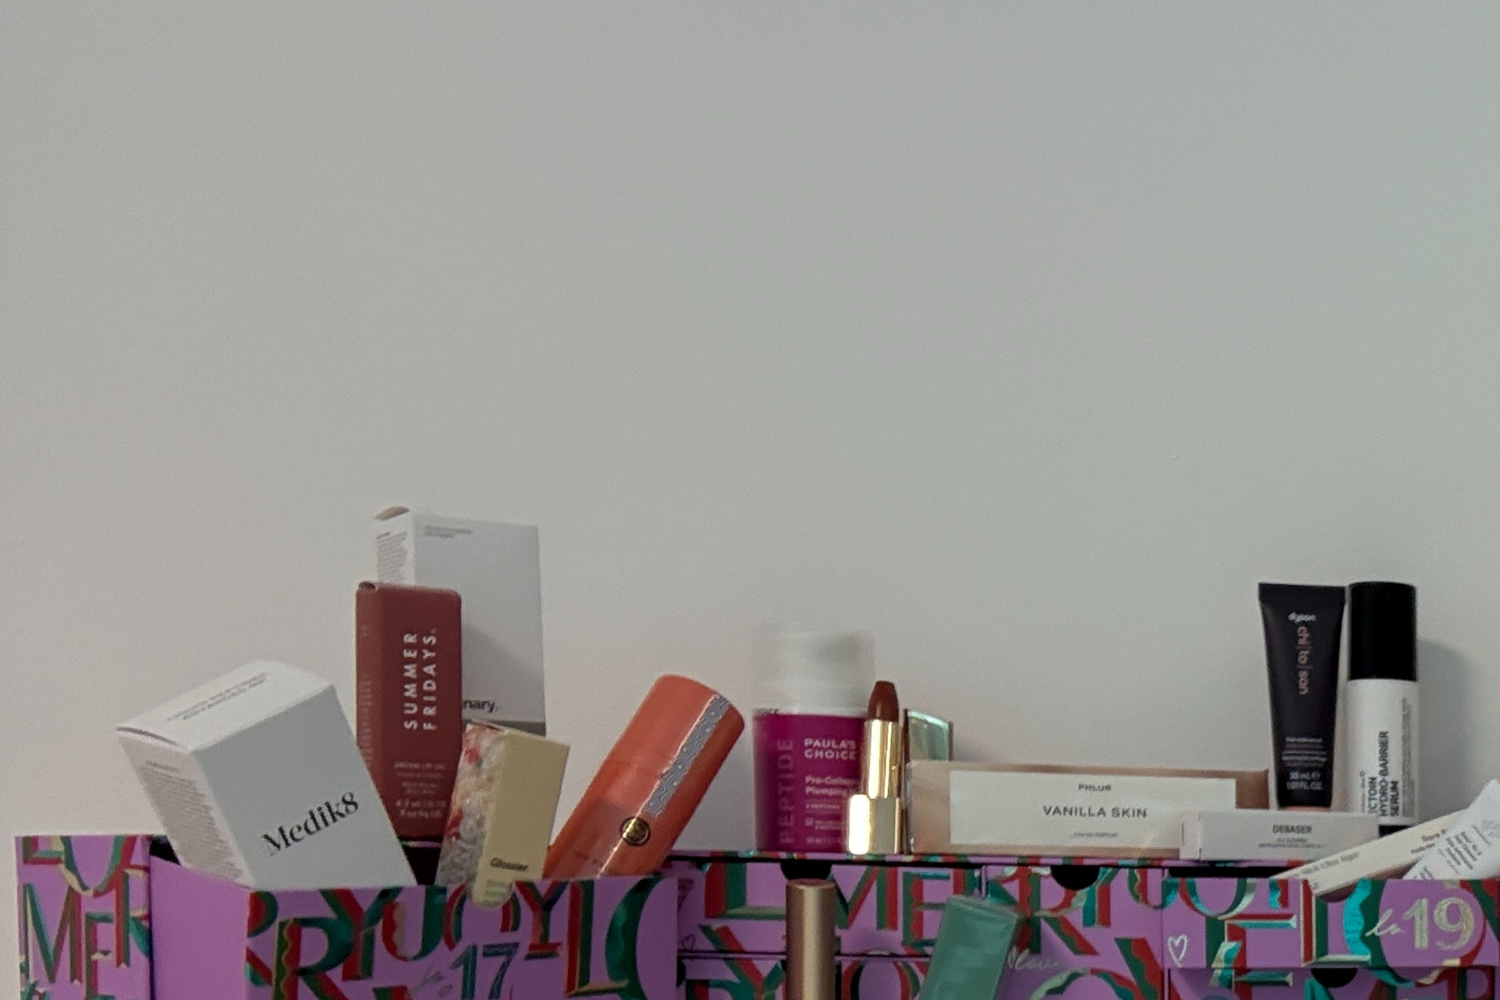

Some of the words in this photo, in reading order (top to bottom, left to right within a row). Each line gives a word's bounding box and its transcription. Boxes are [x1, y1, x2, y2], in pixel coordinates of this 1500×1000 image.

[1287, 611, 1317, 624] dyson
[403, 632, 419, 731] SUMMER
[462, 699, 499, 714] nary.
[804, 737, 856, 750] PAULA'S
[804, 749, 858, 761] CHOICE
[1378, 731, 1390, 817] HYDRO-BARRIER
[776, 738, 795, 844] PEPTIDE
[1390, 780, 1399, 817] SERUM
[1043, 805, 1106, 818] VANILLA
[1110, 807, 1148, 819] SKIN
[261, 791, 359, 856] Medik8
[1271, 824, 1313, 835] DEBASER
[490, 856, 529, 872] Glossier
[1402, 897, 1476, 950] 19
